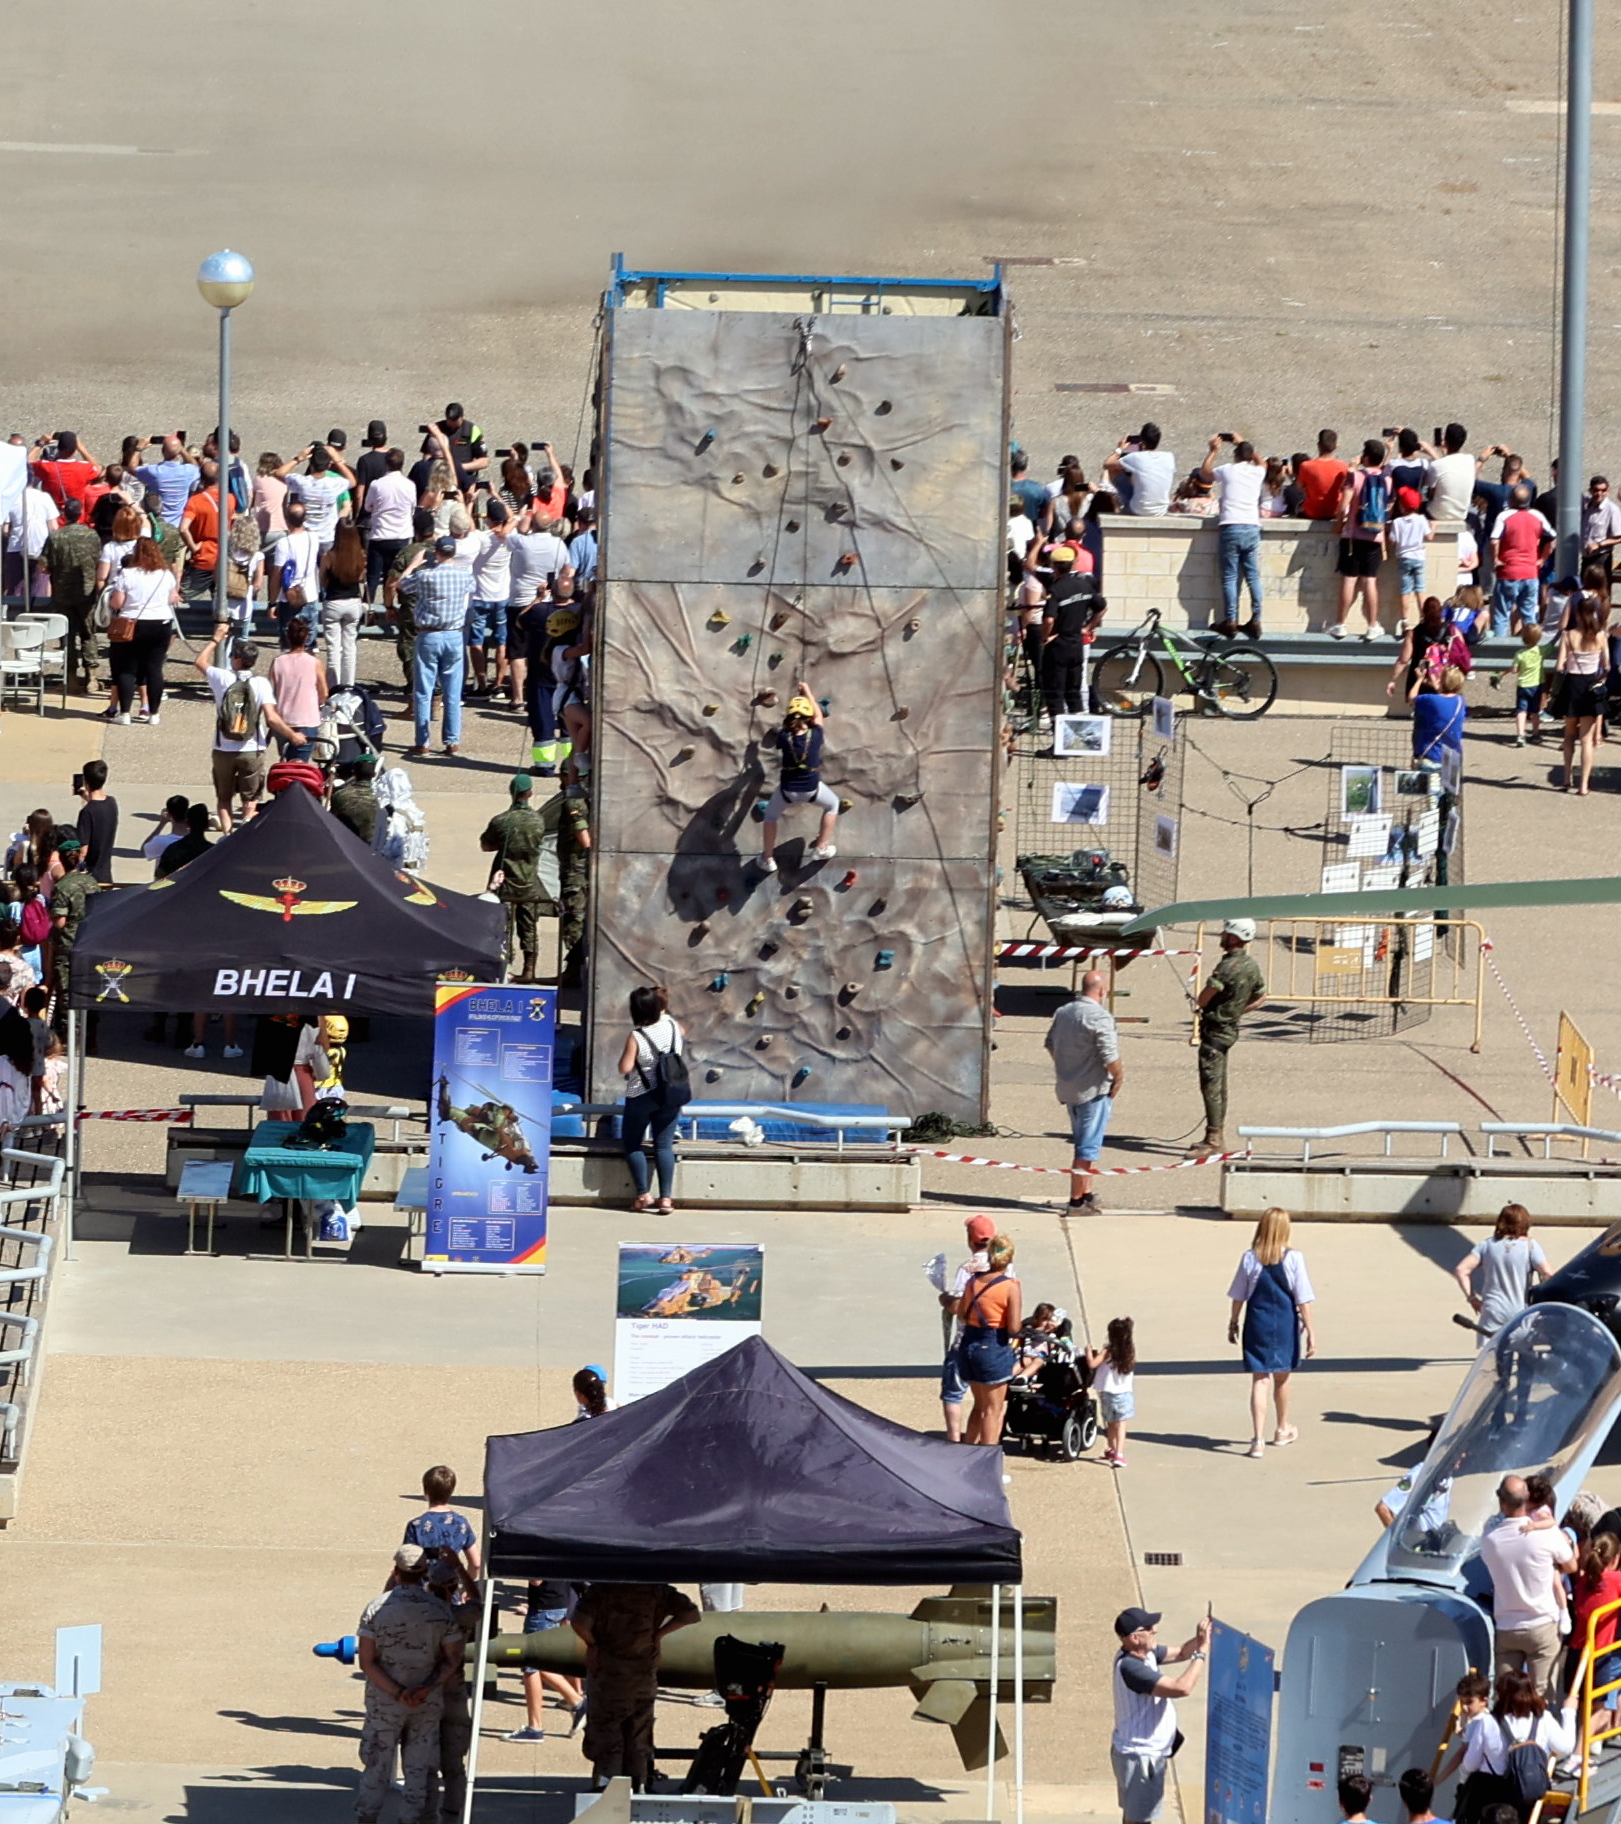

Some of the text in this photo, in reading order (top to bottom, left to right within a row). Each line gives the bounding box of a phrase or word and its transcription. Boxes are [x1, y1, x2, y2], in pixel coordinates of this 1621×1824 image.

[213, 969, 357, 1000] BHELA I
[468, 998, 514, 1013] BHELA
[432, 1132, 447, 1233] TIGRE
[630, 1322, 650, 1331] Tiger
